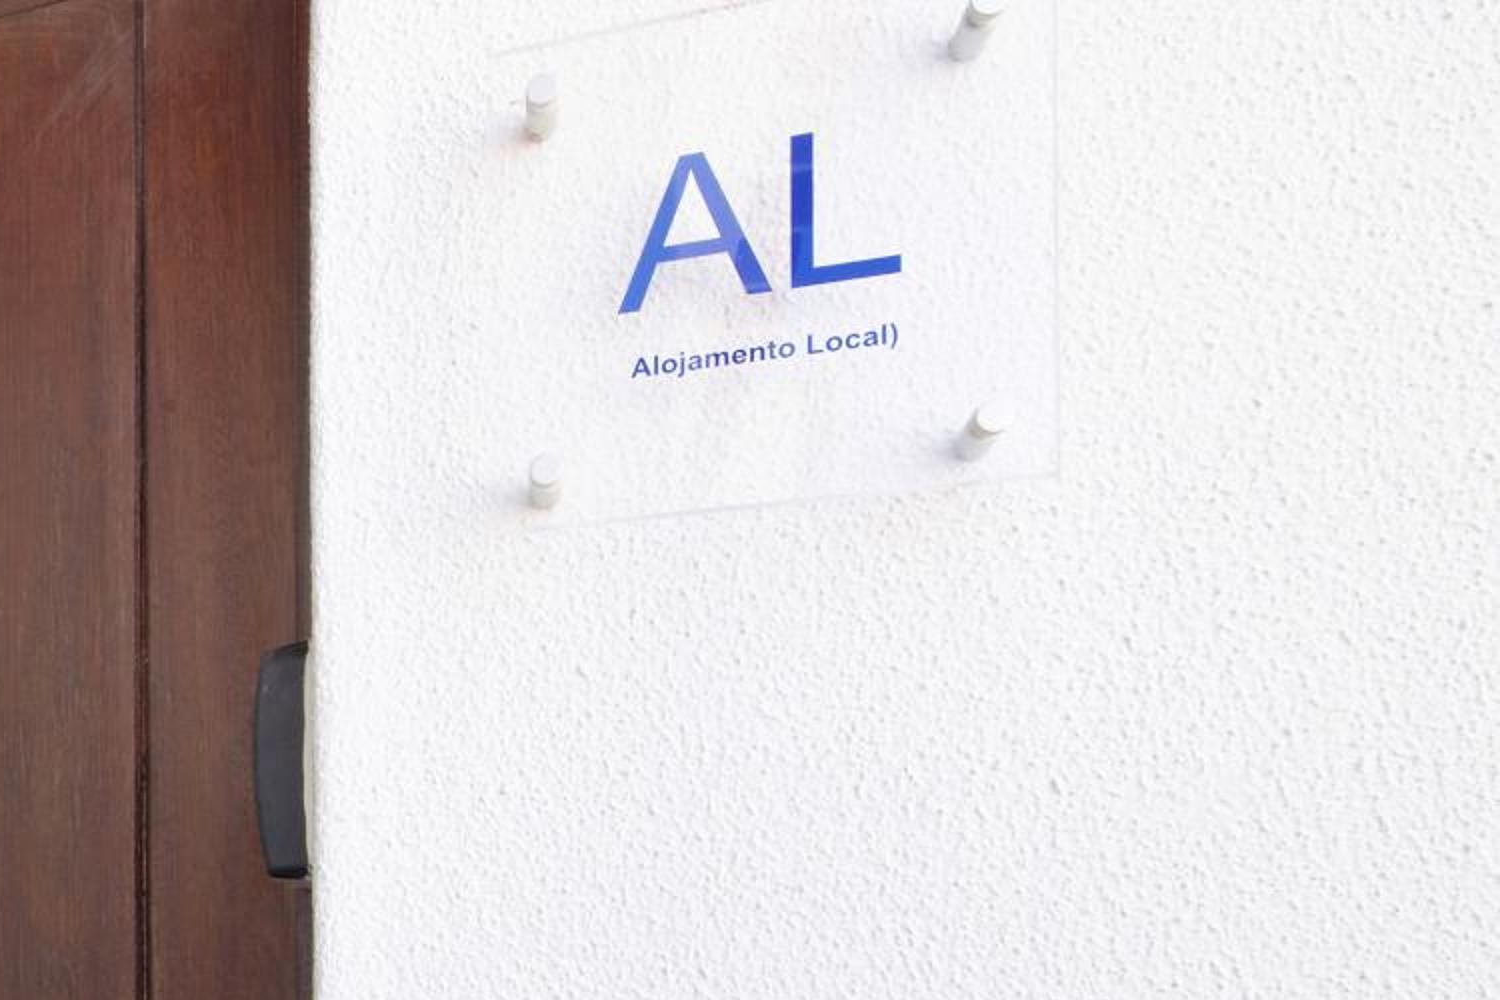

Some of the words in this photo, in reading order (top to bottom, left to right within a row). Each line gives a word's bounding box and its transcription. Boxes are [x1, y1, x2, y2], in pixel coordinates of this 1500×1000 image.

[618, 132, 902, 315] AL
[631, 339, 796, 379] Alojamento
[807, 323, 899, 355] Local)
